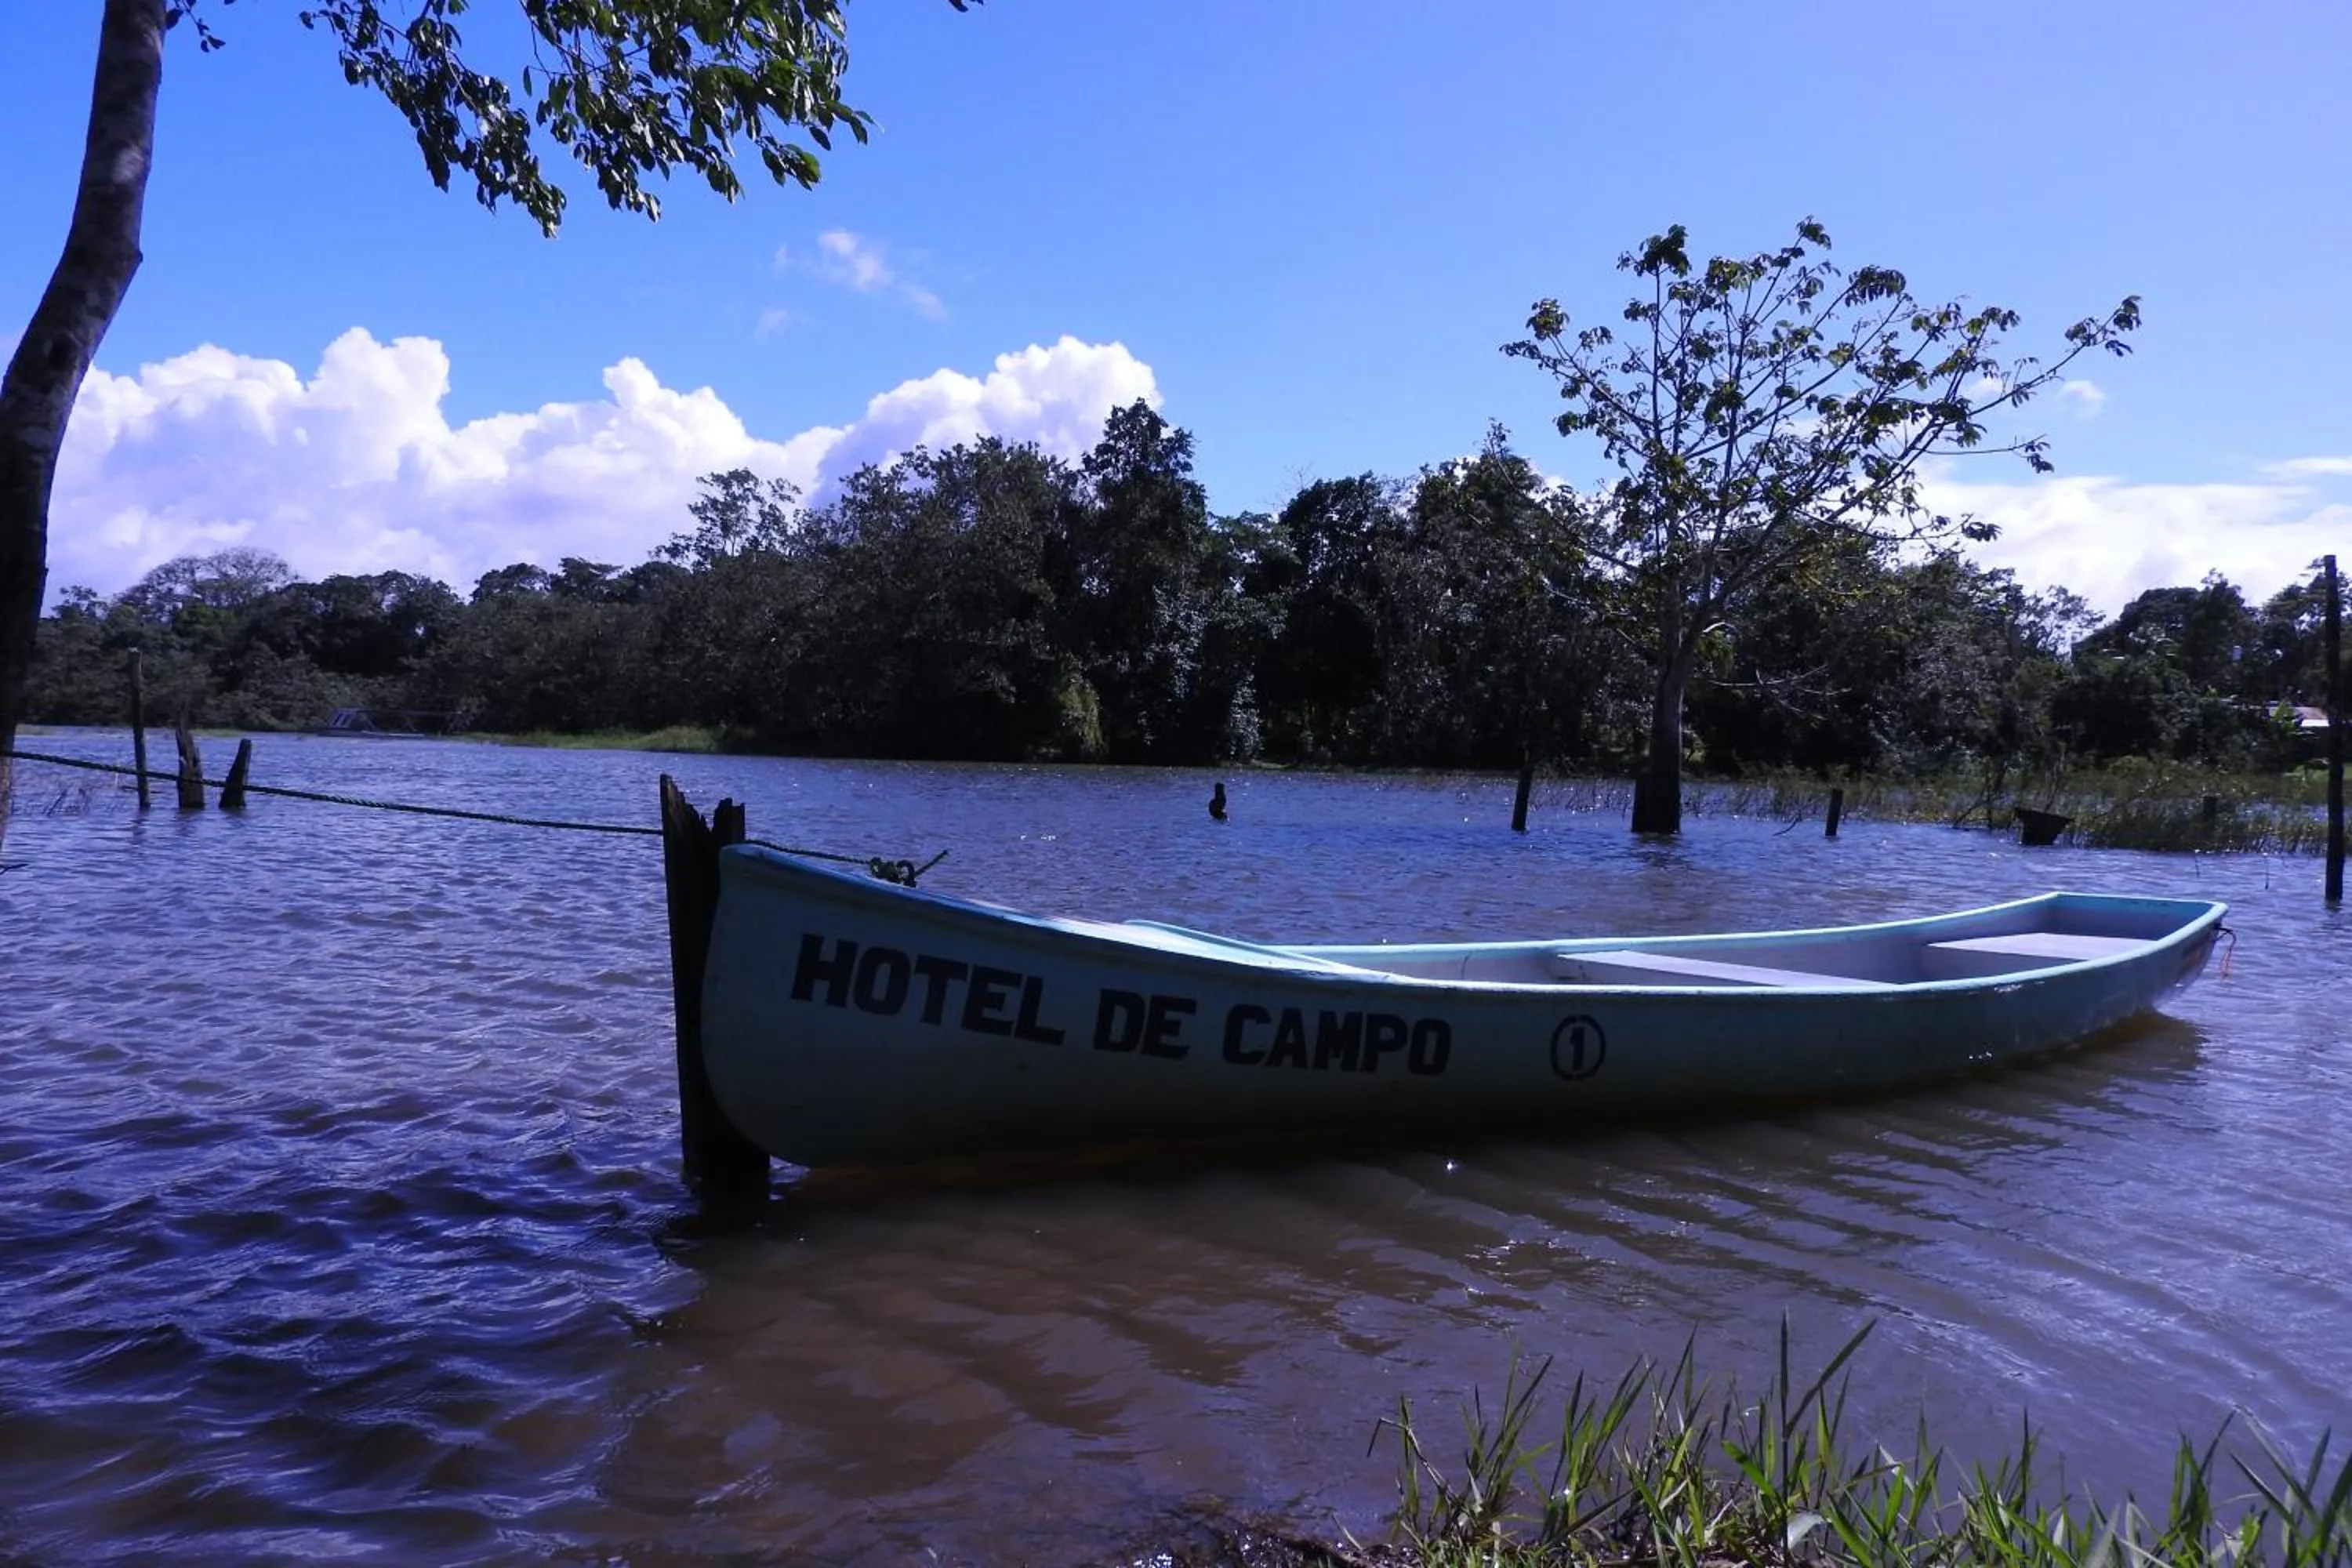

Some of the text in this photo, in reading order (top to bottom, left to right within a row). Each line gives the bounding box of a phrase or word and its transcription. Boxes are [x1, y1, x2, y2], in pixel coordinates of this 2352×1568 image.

[791, 934, 1451, 1075] HOTEL DE CAMPO
